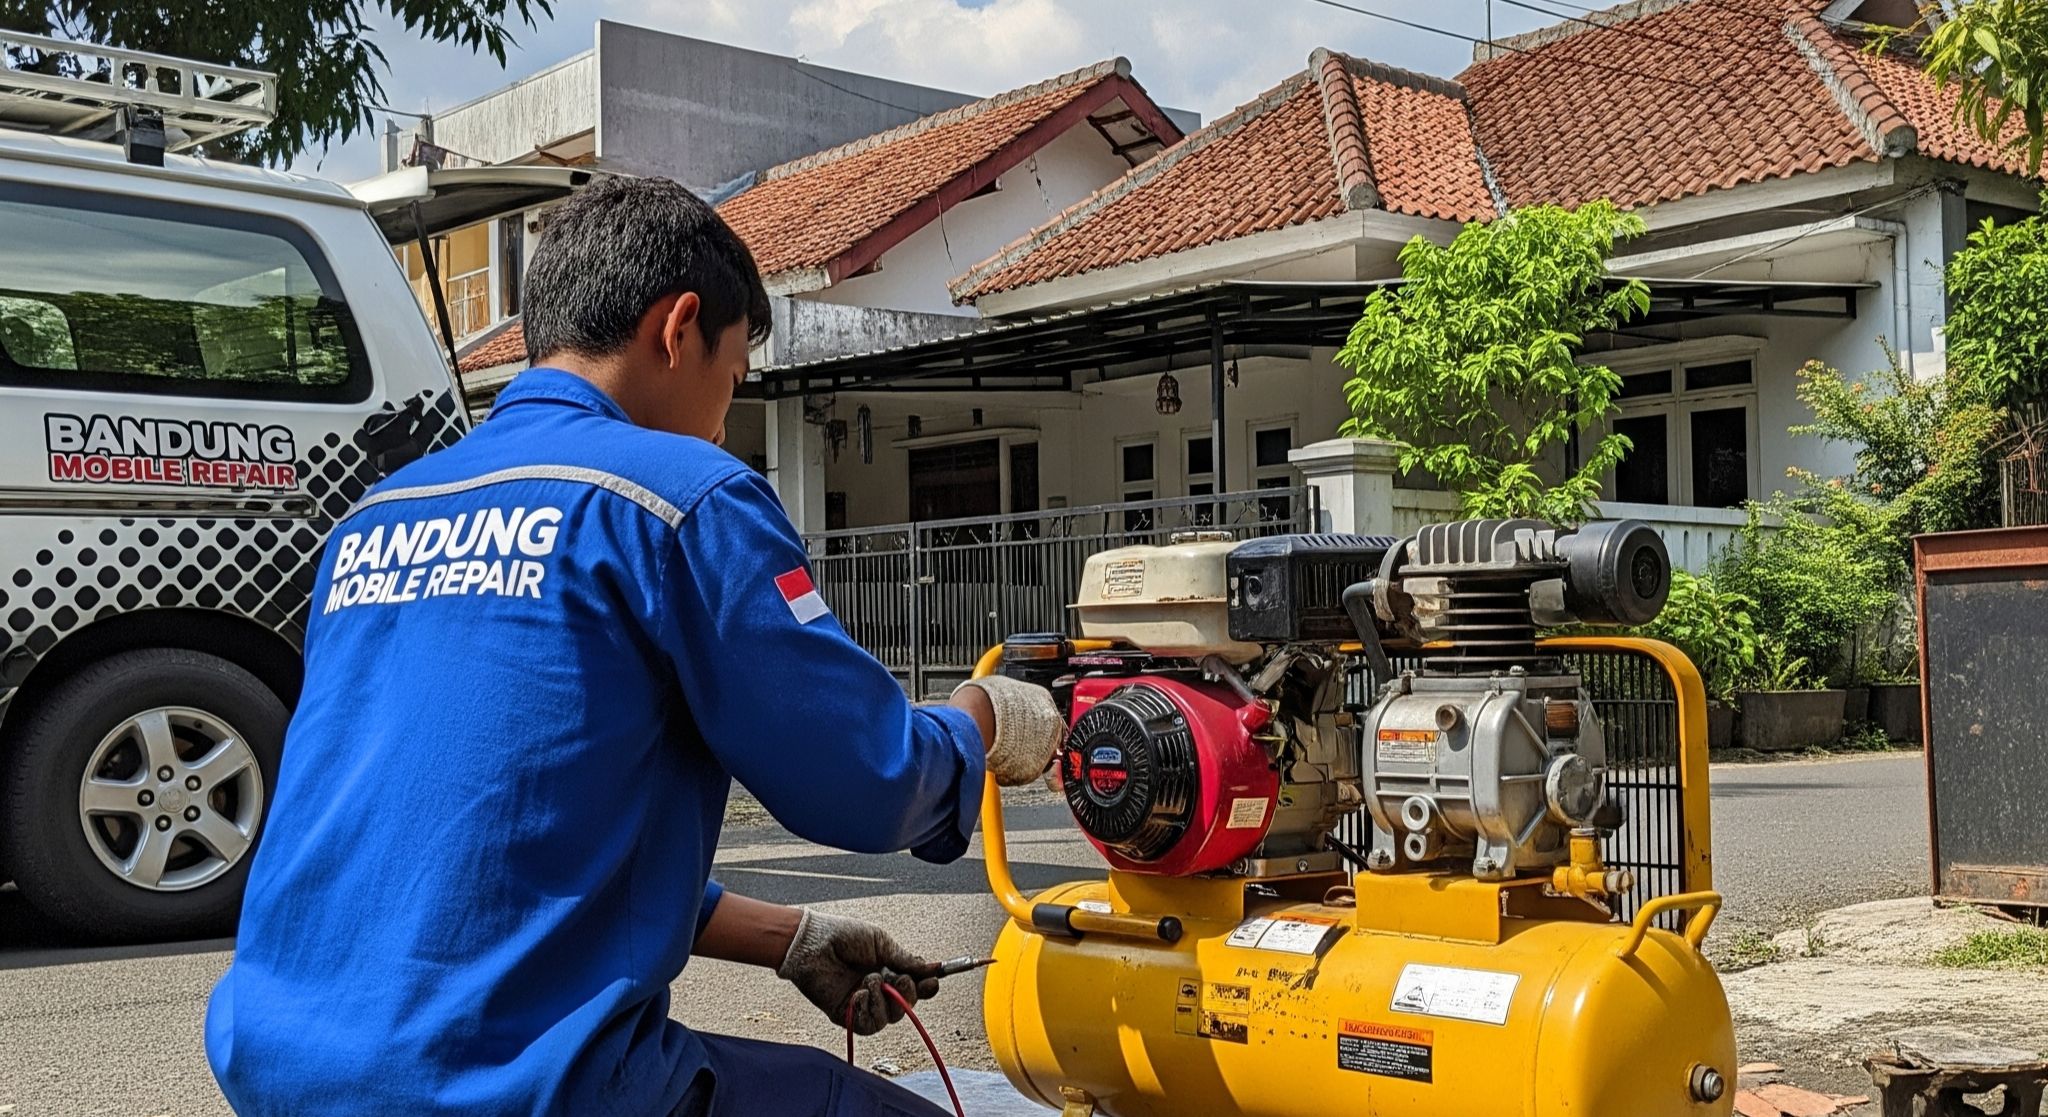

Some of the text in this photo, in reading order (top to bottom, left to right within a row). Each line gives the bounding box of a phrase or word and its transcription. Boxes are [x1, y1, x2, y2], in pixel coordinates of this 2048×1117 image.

[47, 415, 294, 463] BANDUNG
[53, 455, 296, 486] MOBILE REPAIR
[332, 507, 563, 581] BANDUNG
[323, 559, 545, 615] MOBILE REPAIR
